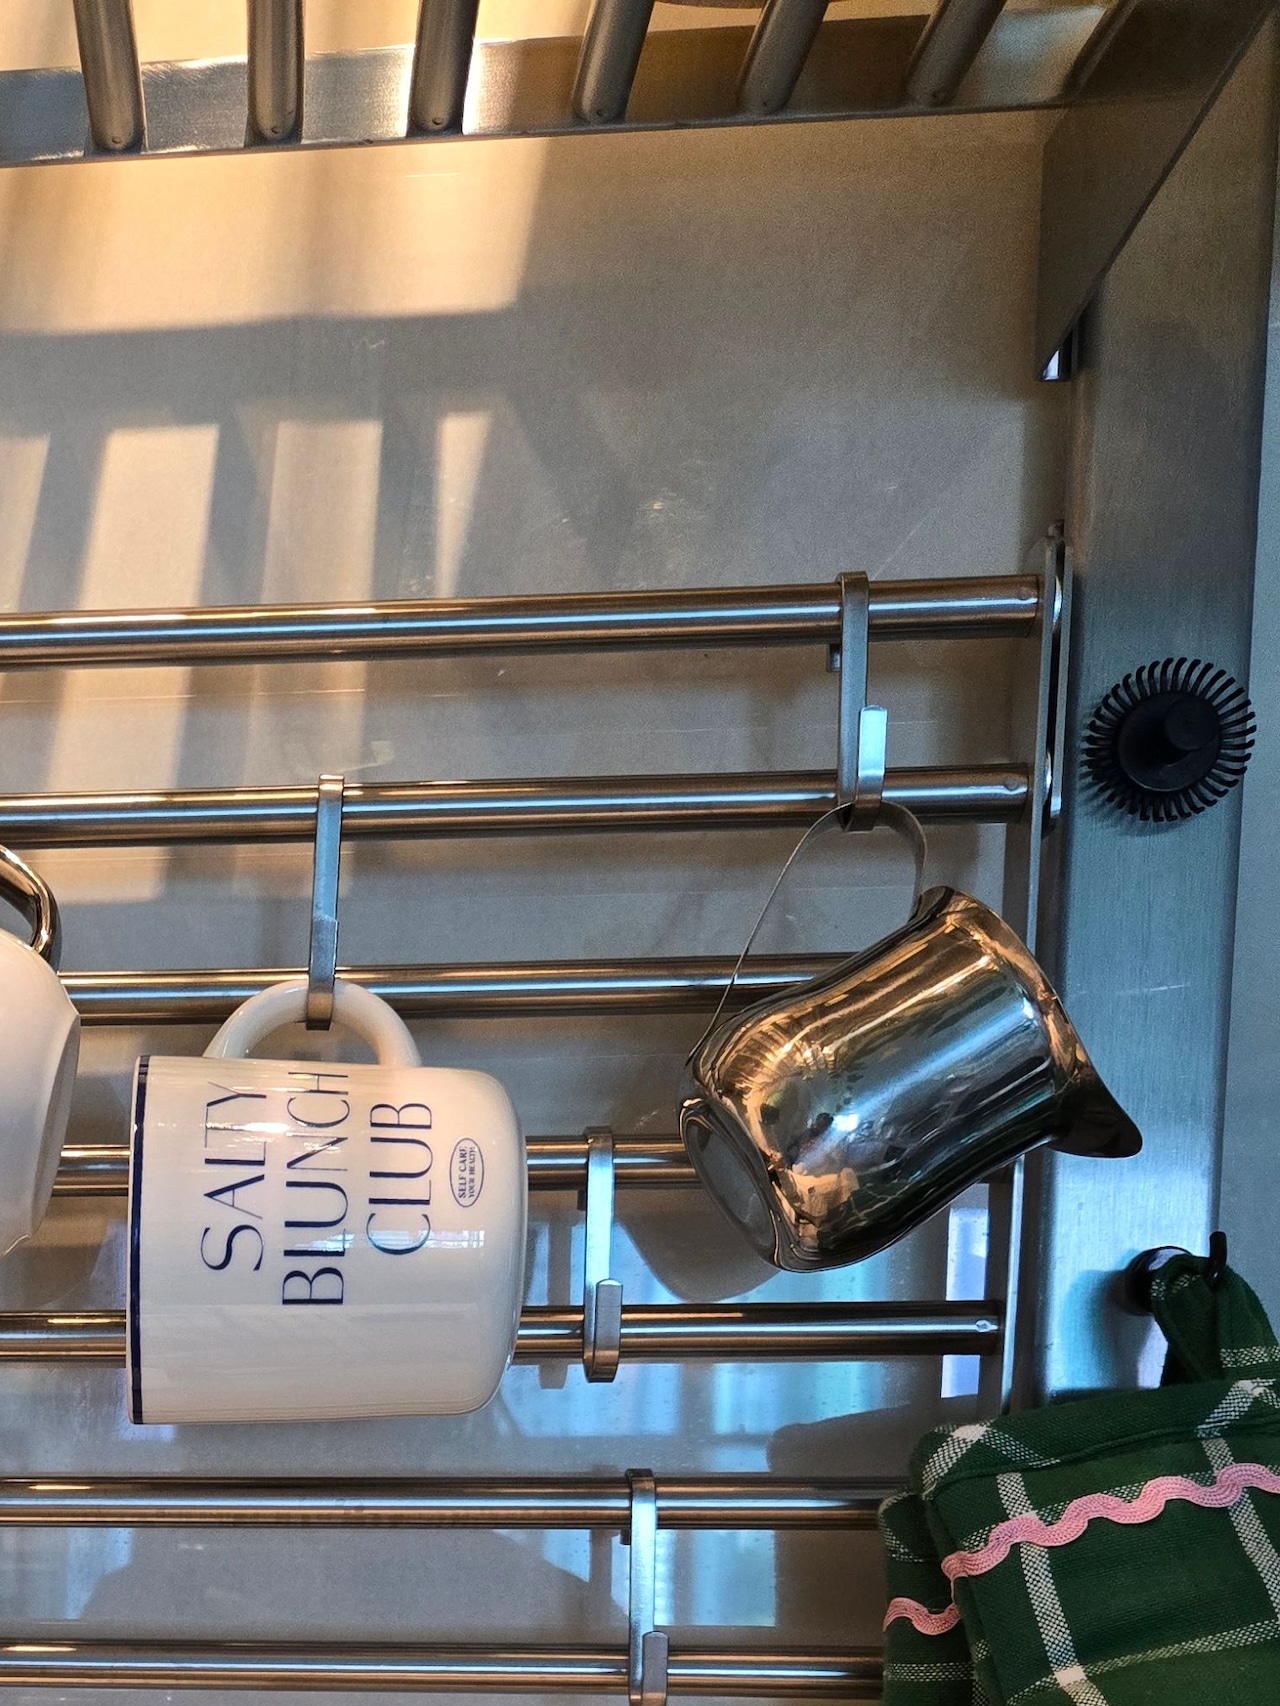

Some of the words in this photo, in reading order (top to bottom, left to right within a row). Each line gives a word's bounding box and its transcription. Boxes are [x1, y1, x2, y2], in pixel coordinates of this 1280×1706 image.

[200, 1081, 268, 1272] SALTY
[281, 1071, 352, 1306] BLUNCH
[366, 1103, 433, 1256] CLUB
[458, 1146, 468, 1173] CARE
[458, 1174, 467, 1199] SELF
